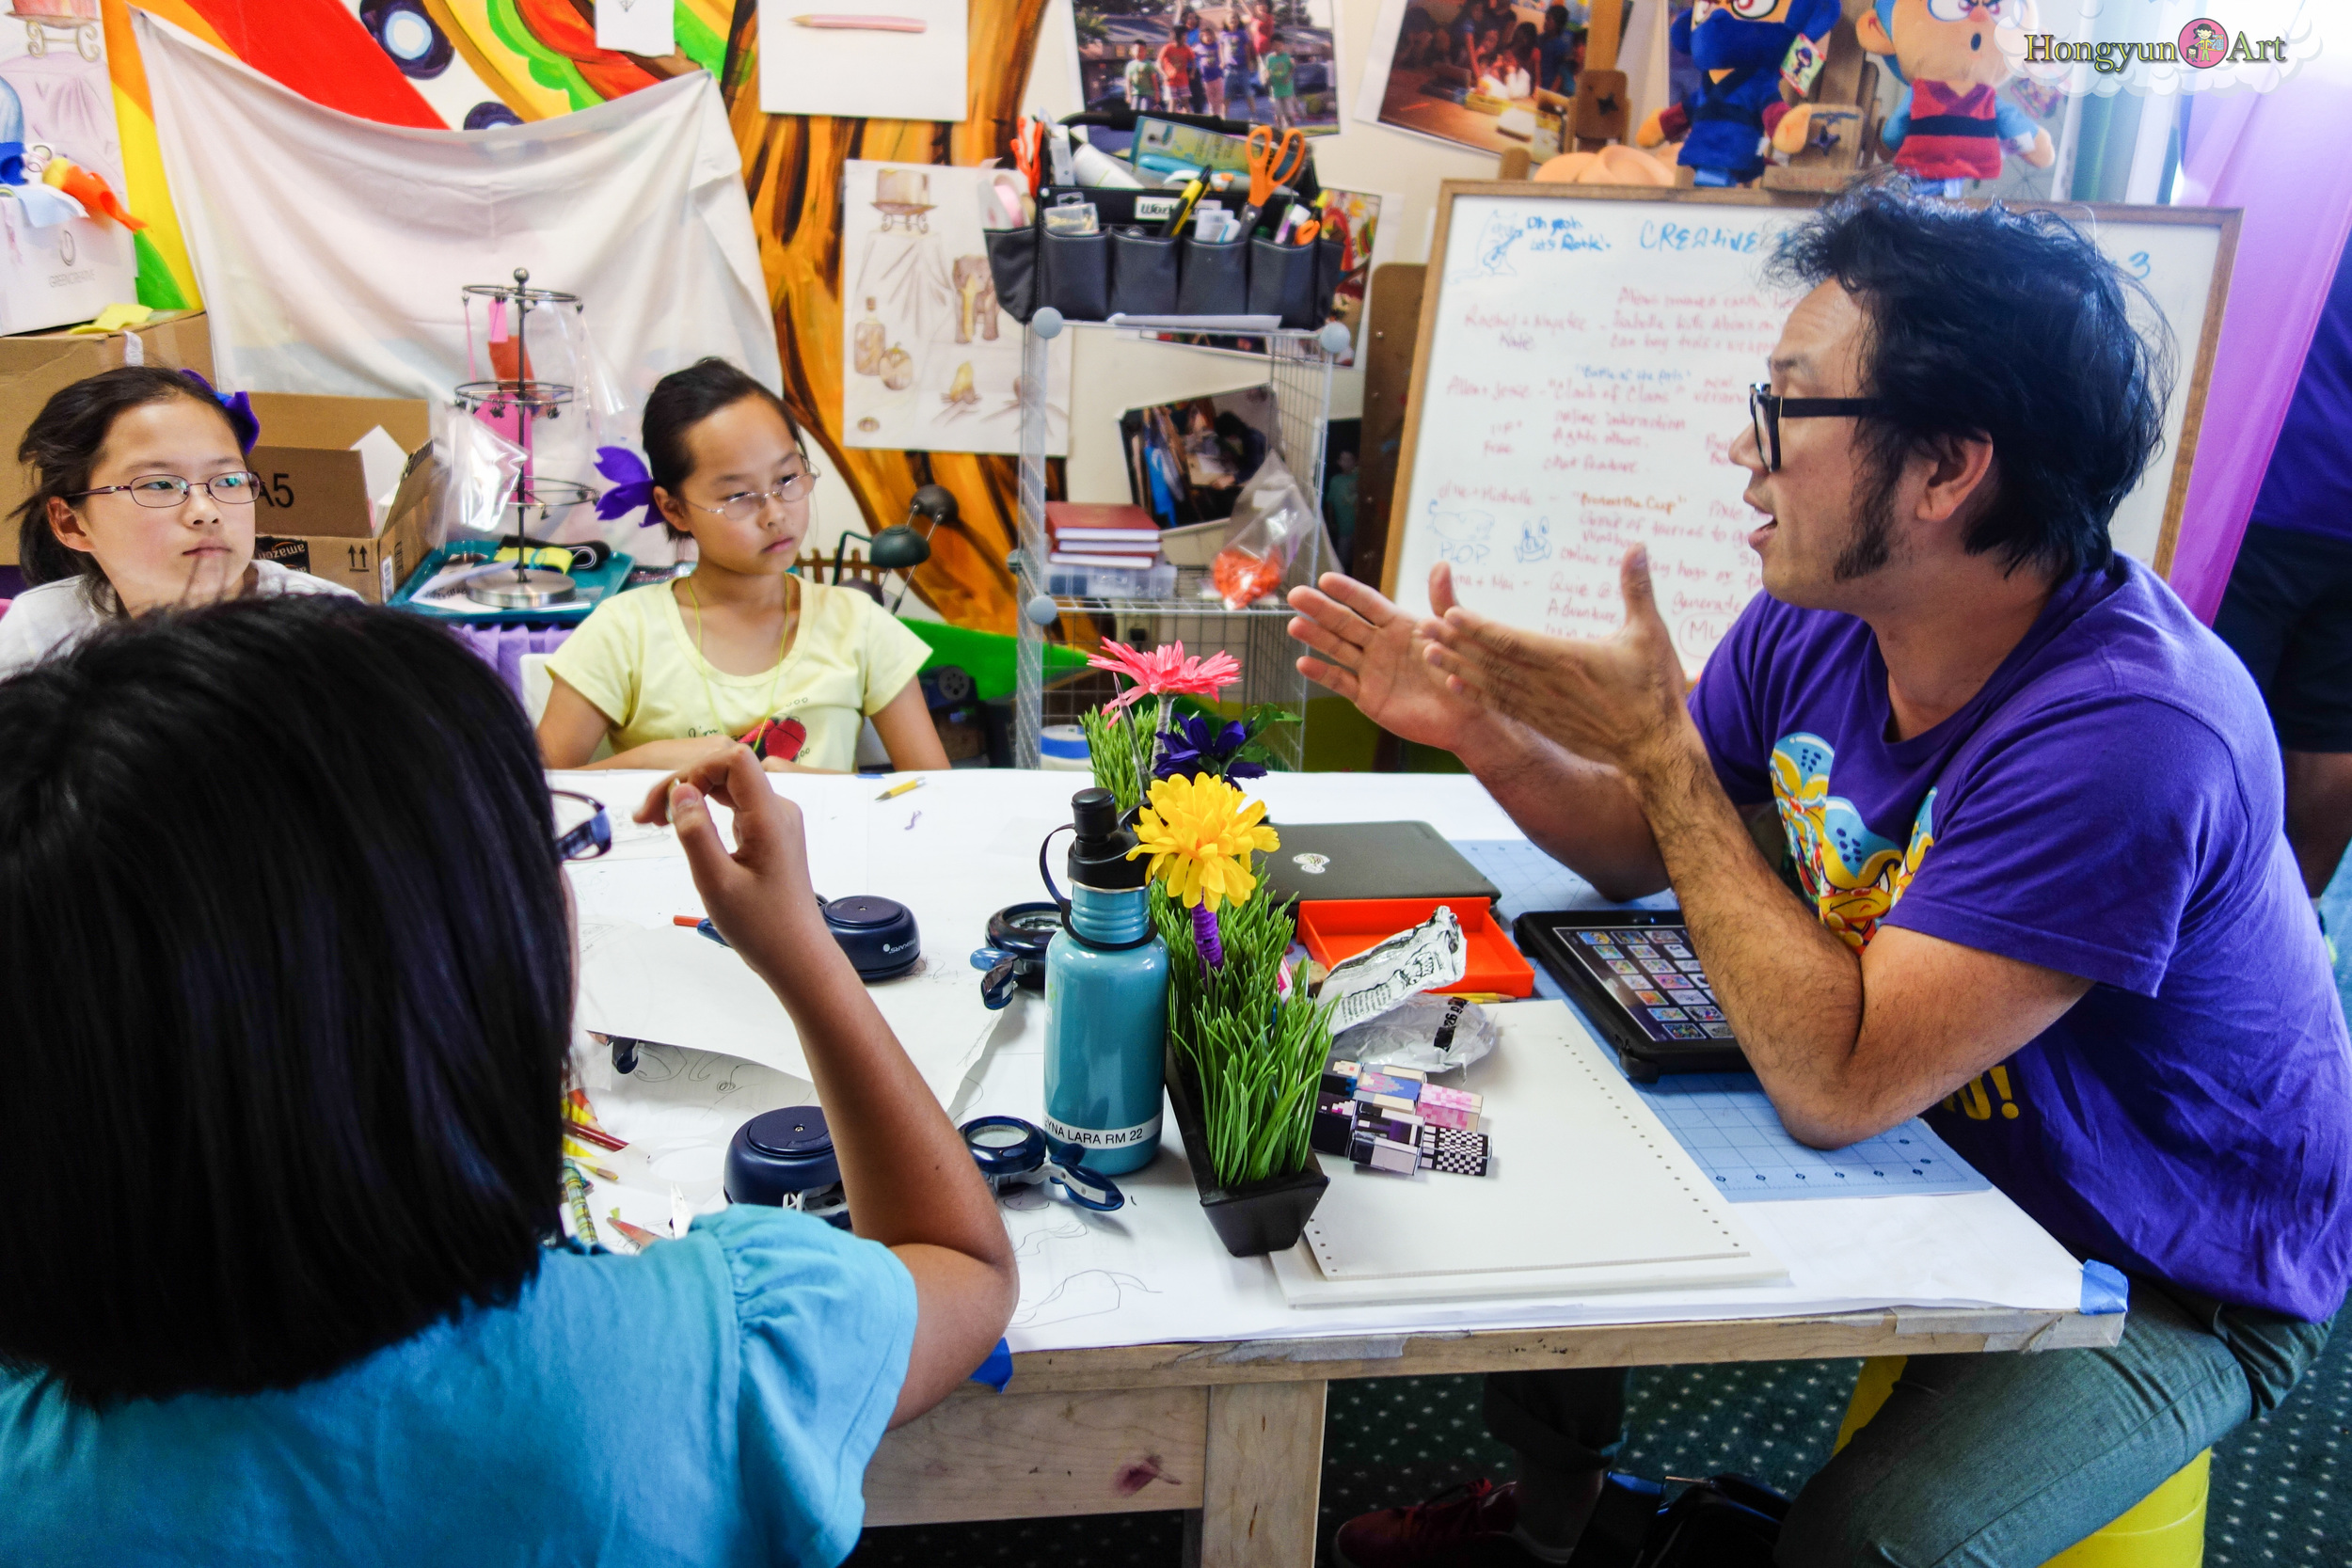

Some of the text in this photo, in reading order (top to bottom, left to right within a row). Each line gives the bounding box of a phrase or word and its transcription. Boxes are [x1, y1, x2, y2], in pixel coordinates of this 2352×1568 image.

[258, 543, 306, 560] amazon
[1067, 1129, 1102, 1145] LARA
[1105, 1132, 1126, 1145] RM
[1129, 1128, 1143, 1142] 22
